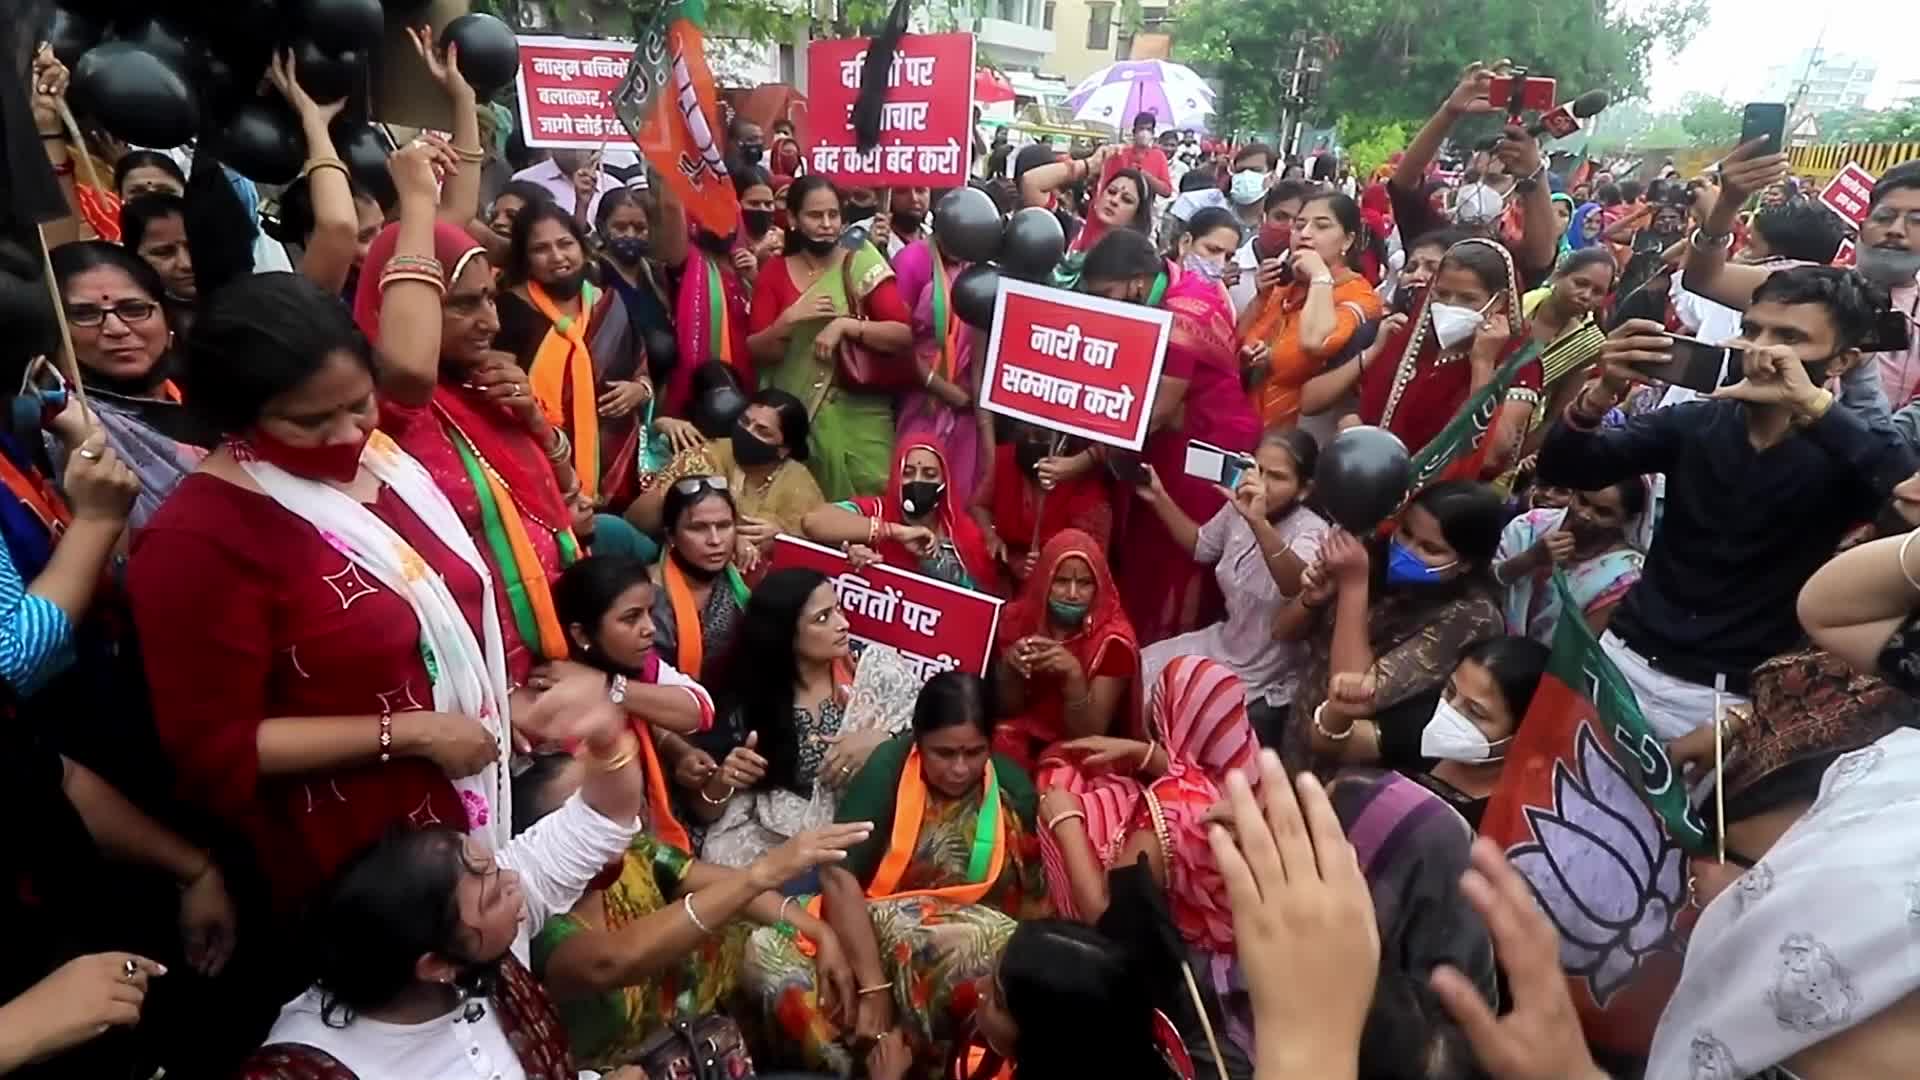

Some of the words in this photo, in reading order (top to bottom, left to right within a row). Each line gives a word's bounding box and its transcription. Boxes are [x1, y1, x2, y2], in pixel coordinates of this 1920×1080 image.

[532, 57, 580, 81] मासूम
[905, 56, 936, 87] पर
[538, 113, 573, 135] जागो
[575, 114, 603, 136] सोई
[812, 139, 841, 174] बंद
[885, 138, 915, 174] बंद
[917, 136, 961, 174] करो
[1030, 323, 1082, 362] नारी
[1082, 337, 1119, 369] का
[1001, 363, 1082, 409] सम्मान
[1082, 383, 1135, 422] करो
[827, 572, 904, 624] लितों
[902, 600, 942, 637] पर
